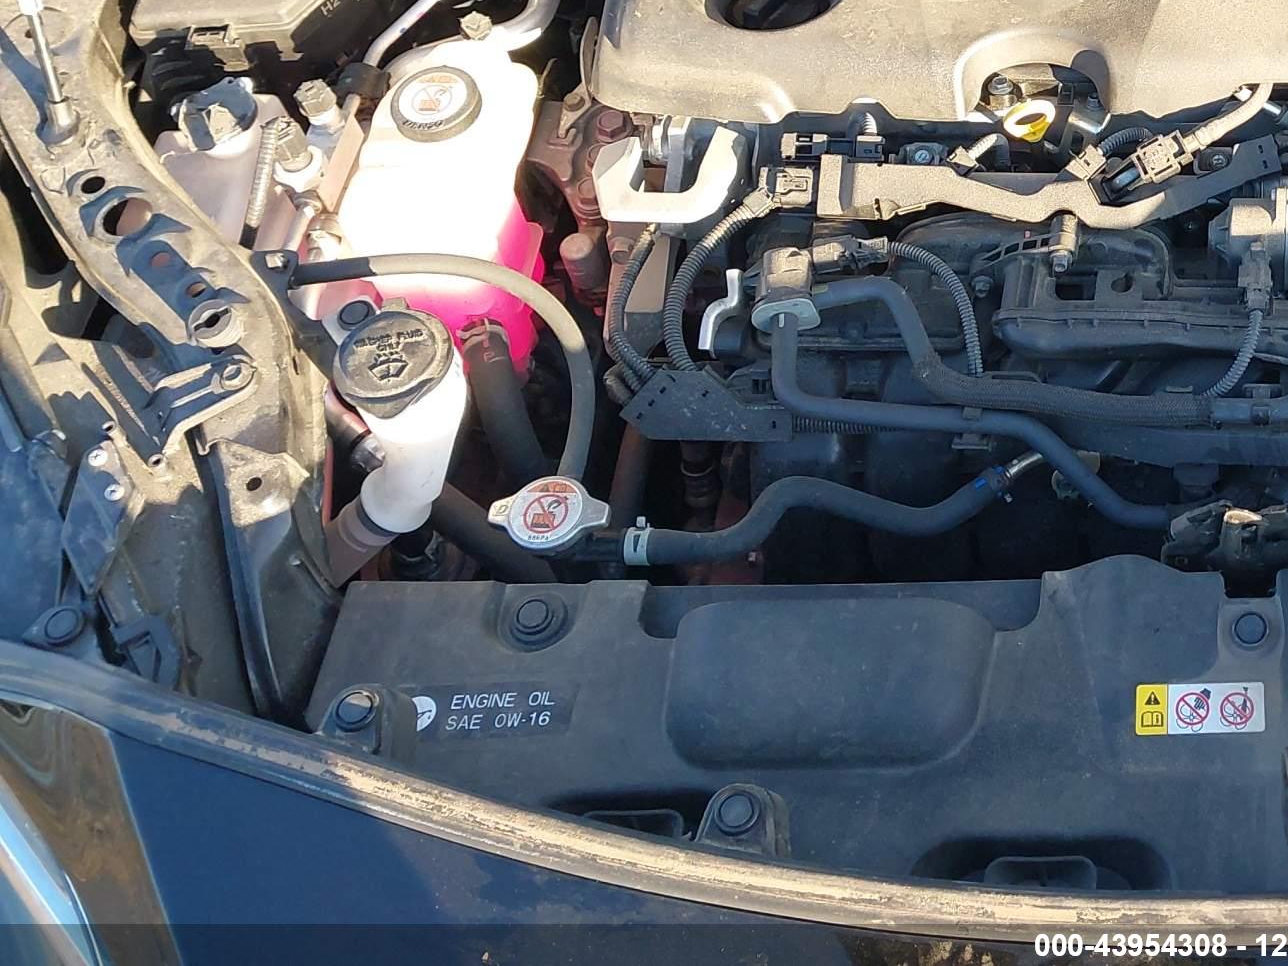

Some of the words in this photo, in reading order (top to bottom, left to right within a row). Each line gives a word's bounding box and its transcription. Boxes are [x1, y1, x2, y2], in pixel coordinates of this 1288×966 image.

[450, 692, 517, 710] ENGINE
[528, 691, 555, 706] OIL
[445, 714, 483, 731] SAE
